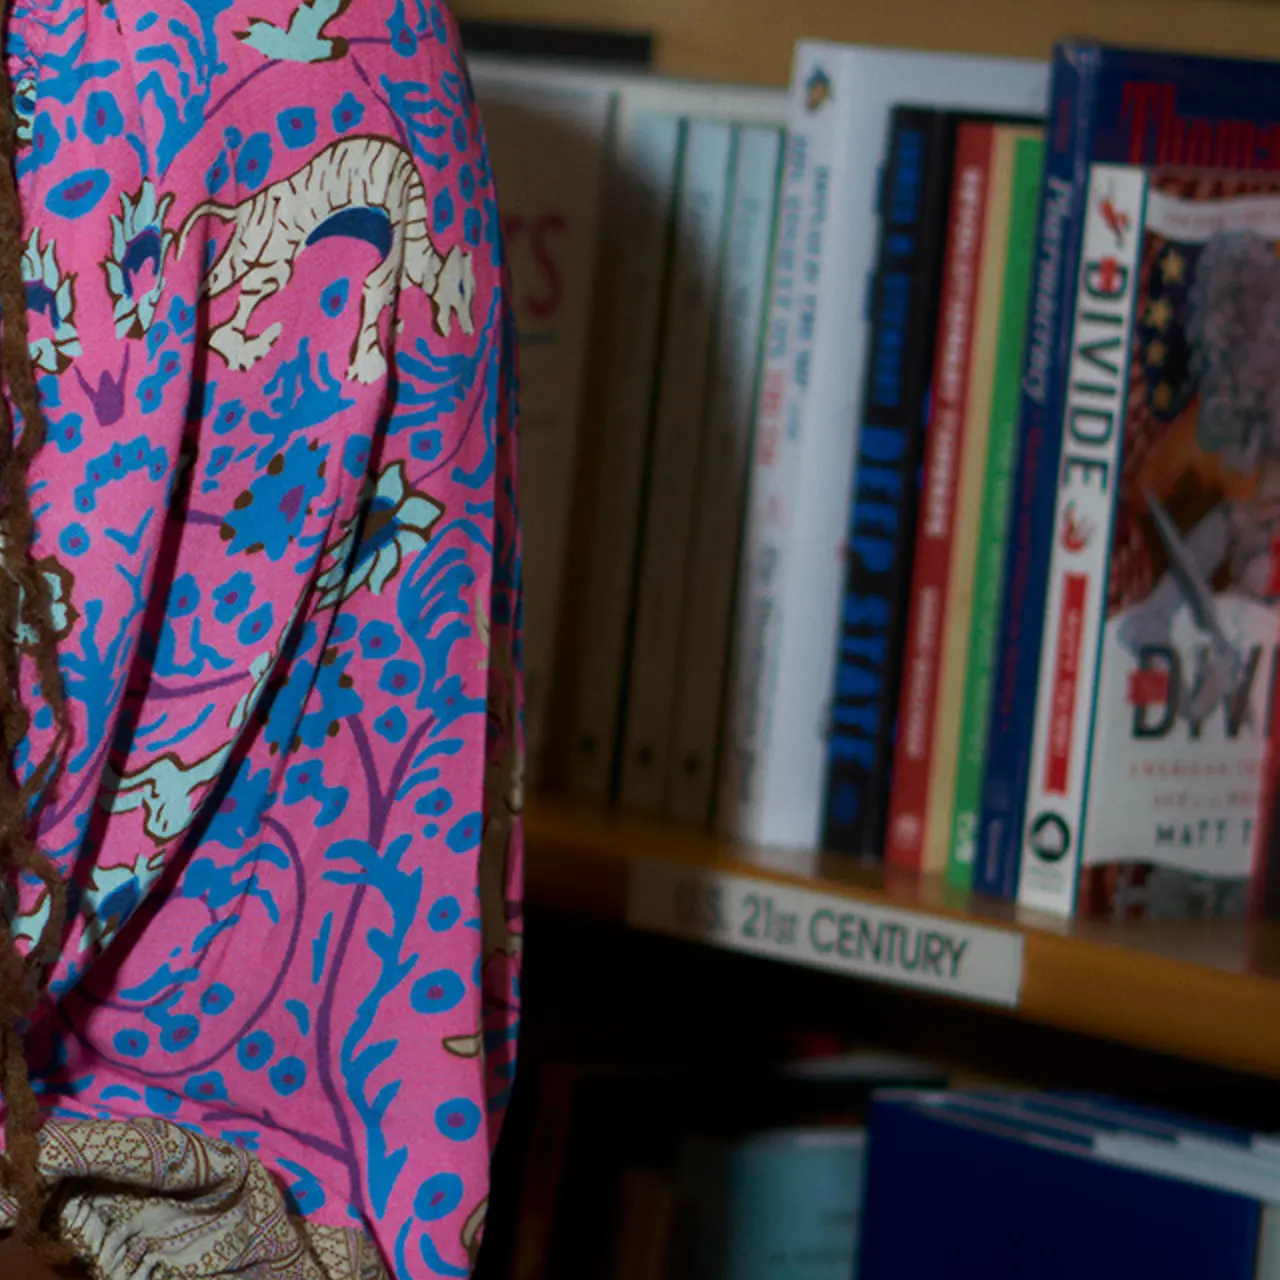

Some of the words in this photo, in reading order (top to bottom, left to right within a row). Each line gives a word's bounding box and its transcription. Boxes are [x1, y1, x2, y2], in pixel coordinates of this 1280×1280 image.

[1061, 259, 1131, 495] DIVIDE
[847, 423, 908, 574] DEEP
[828, 592, 893, 772] STATE
[1154, 821, 1228, 847] MATT
[809, 909, 969, 979] CENTURY
